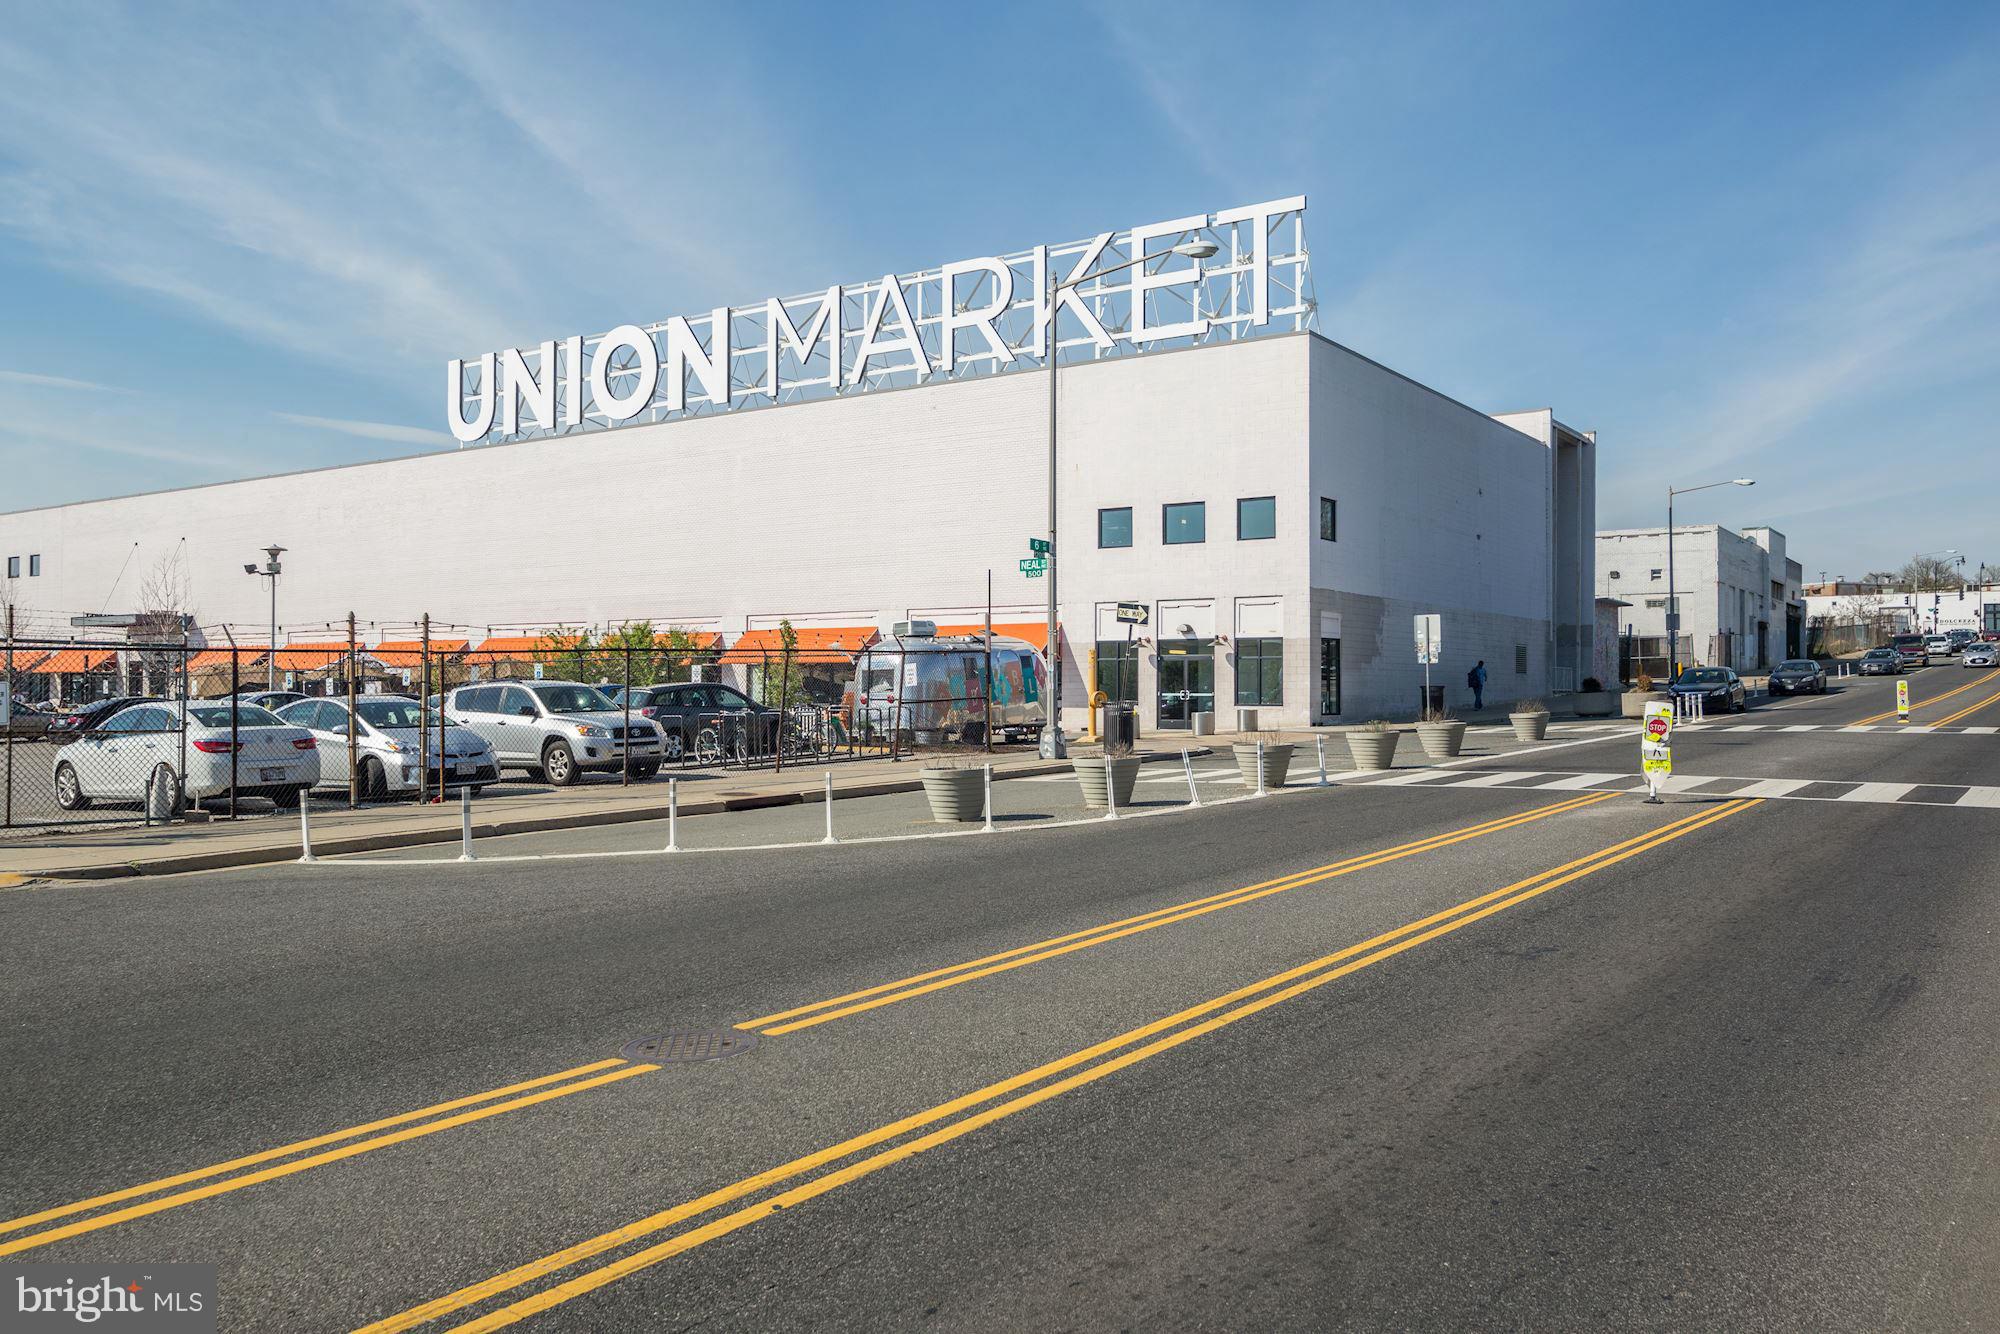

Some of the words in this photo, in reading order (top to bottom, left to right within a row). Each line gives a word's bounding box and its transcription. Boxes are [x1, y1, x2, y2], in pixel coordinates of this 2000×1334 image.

[448, 307, 731, 442] UNION
[767, 195, 1307, 397] MARKET
[1021, 560, 1041, 570] NEAL
[1119, 609, 1129, 617] ONE
[1131, 610, 1143, 618] WAY
[1649, 723, 1667, 732] STOP
